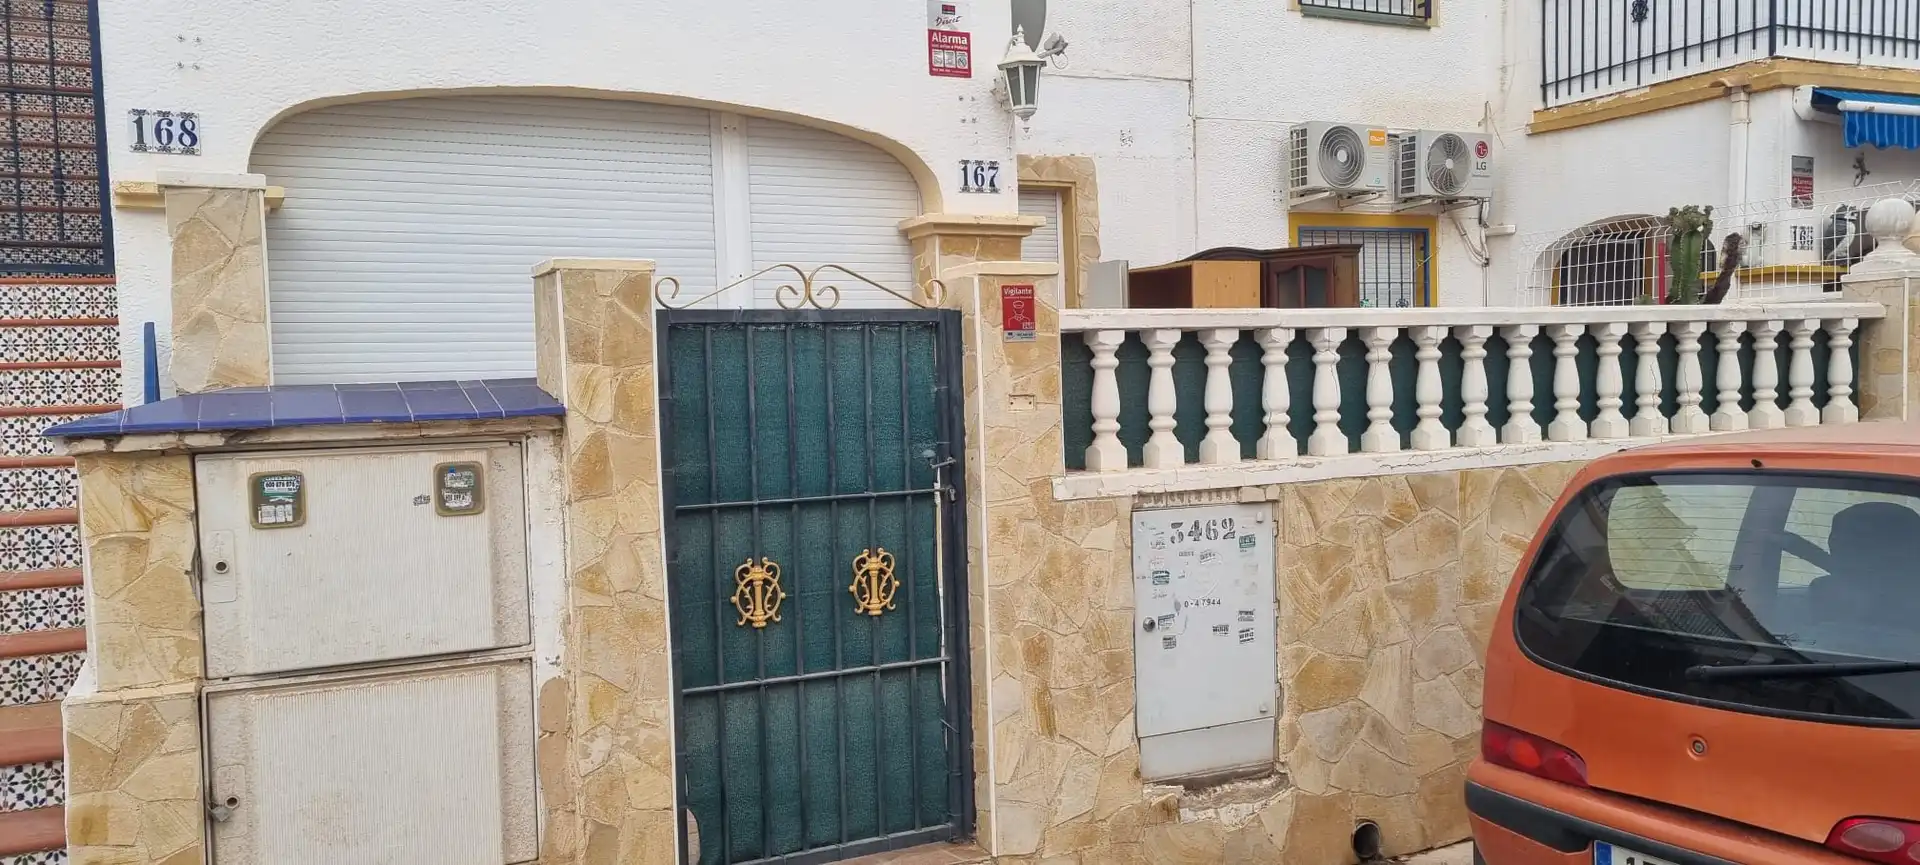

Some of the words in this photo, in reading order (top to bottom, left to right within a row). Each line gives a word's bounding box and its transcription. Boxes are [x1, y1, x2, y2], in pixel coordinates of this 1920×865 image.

[932, 32, 968, 45] Alarma
[132, 116, 198, 148] 168
[1476, 161, 1487, 171] LG
[960, 164, 999, 188] 167
[1004, 287, 1033, 296] Vigilante
